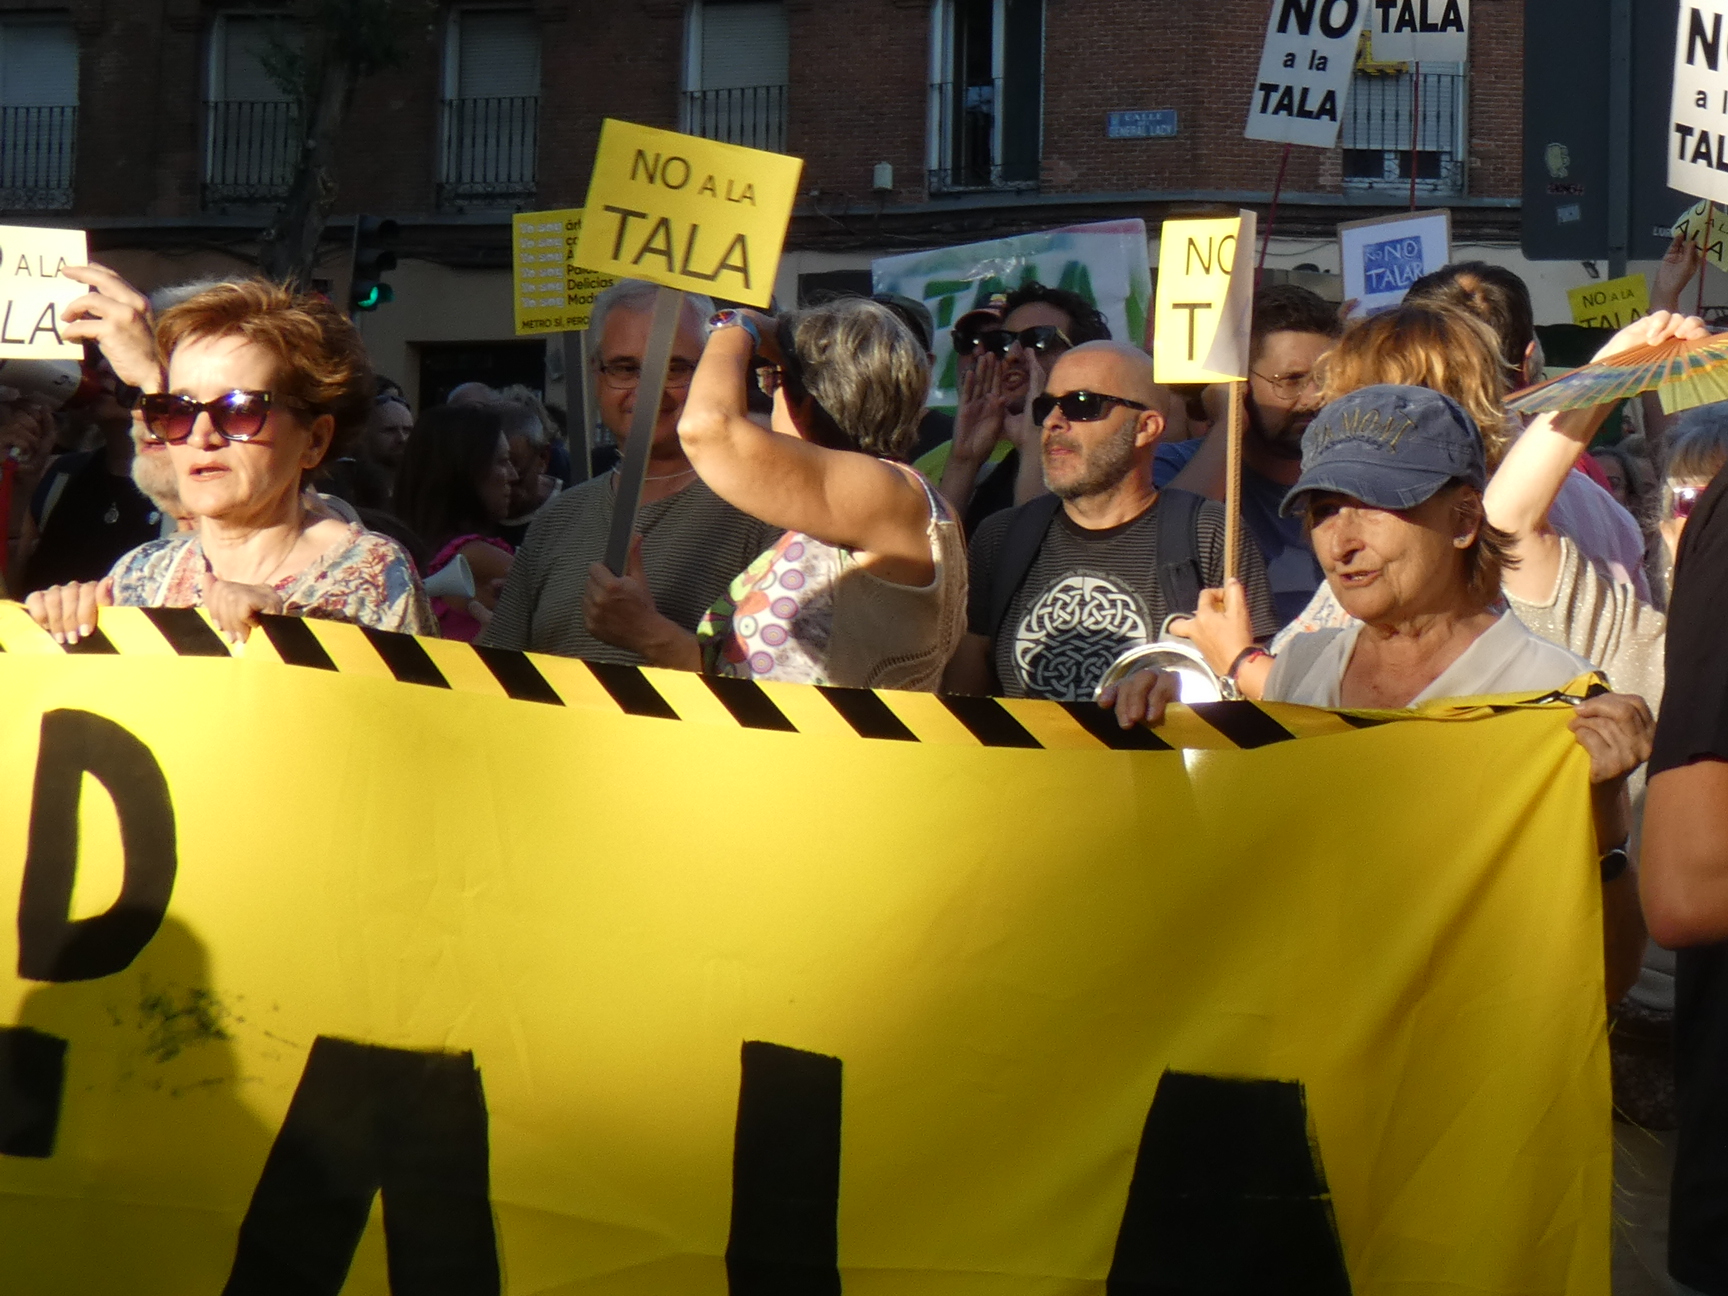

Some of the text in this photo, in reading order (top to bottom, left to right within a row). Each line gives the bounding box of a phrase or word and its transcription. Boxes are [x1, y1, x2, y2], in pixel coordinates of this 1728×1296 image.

[1283, 49, 1329, 72] a la
[1258, 82, 1338, 123] TALA
[1695, 89, 1707, 110] a
[629, 148, 757, 207] NO A LA
[603, 204, 753, 291] TALA
[1186, 234, 1237, 276] NO
[14, 254, 32, 277] A
[1366, 262, 1423, 290] TALAR
[567, 278, 614, 291] Delicias
[1582, 289, 1635, 309] NO A LA
[17, 707, 178, 983] D
